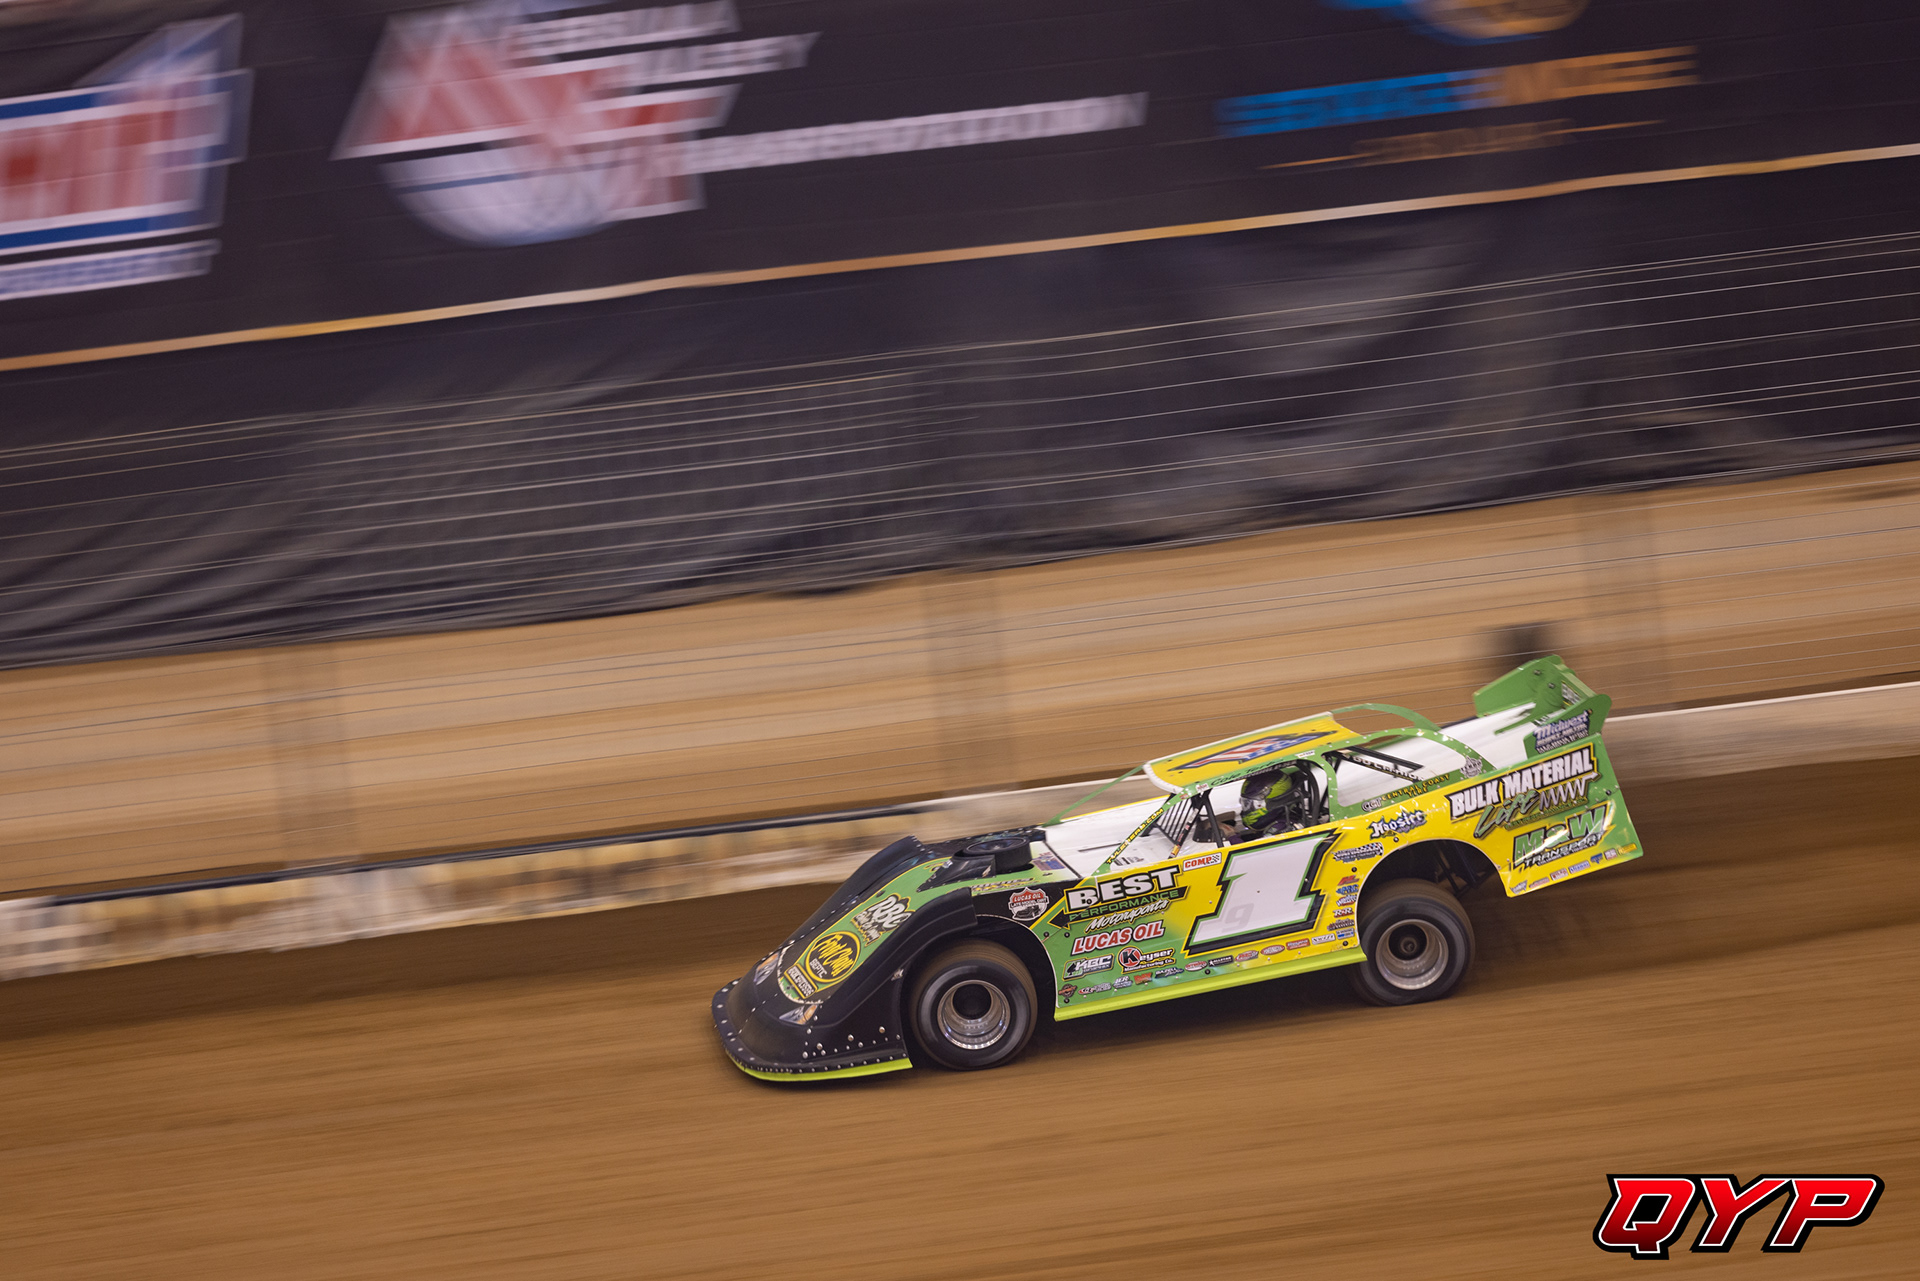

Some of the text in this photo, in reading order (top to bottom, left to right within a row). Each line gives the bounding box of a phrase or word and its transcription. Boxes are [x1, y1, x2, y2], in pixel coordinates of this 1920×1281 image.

[1381, 773, 1450, 801] CENTRAL COAST
[1449, 780, 1500, 818] BULK
[1502, 748, 1593, 799] MATERIAL
[1371, 810, 1427, 840] Hoosier
[1184, 856, 1213, 869] COMP
[1524, 832, 1602, 867] TRANSPORT
[1066, 865, 1180, 912] BEST
[1189, 832, 1332, 947] 1
[1068, 889, 1180, 922] PERFORMANCE
[1072, 919, 1166, 956] LUCAS OIL
[1074, 954, 1113, 971] KBC
[1121, 947, 1174, 966] Keyser
[1124, 960, 1164, 972] Manufacturing
